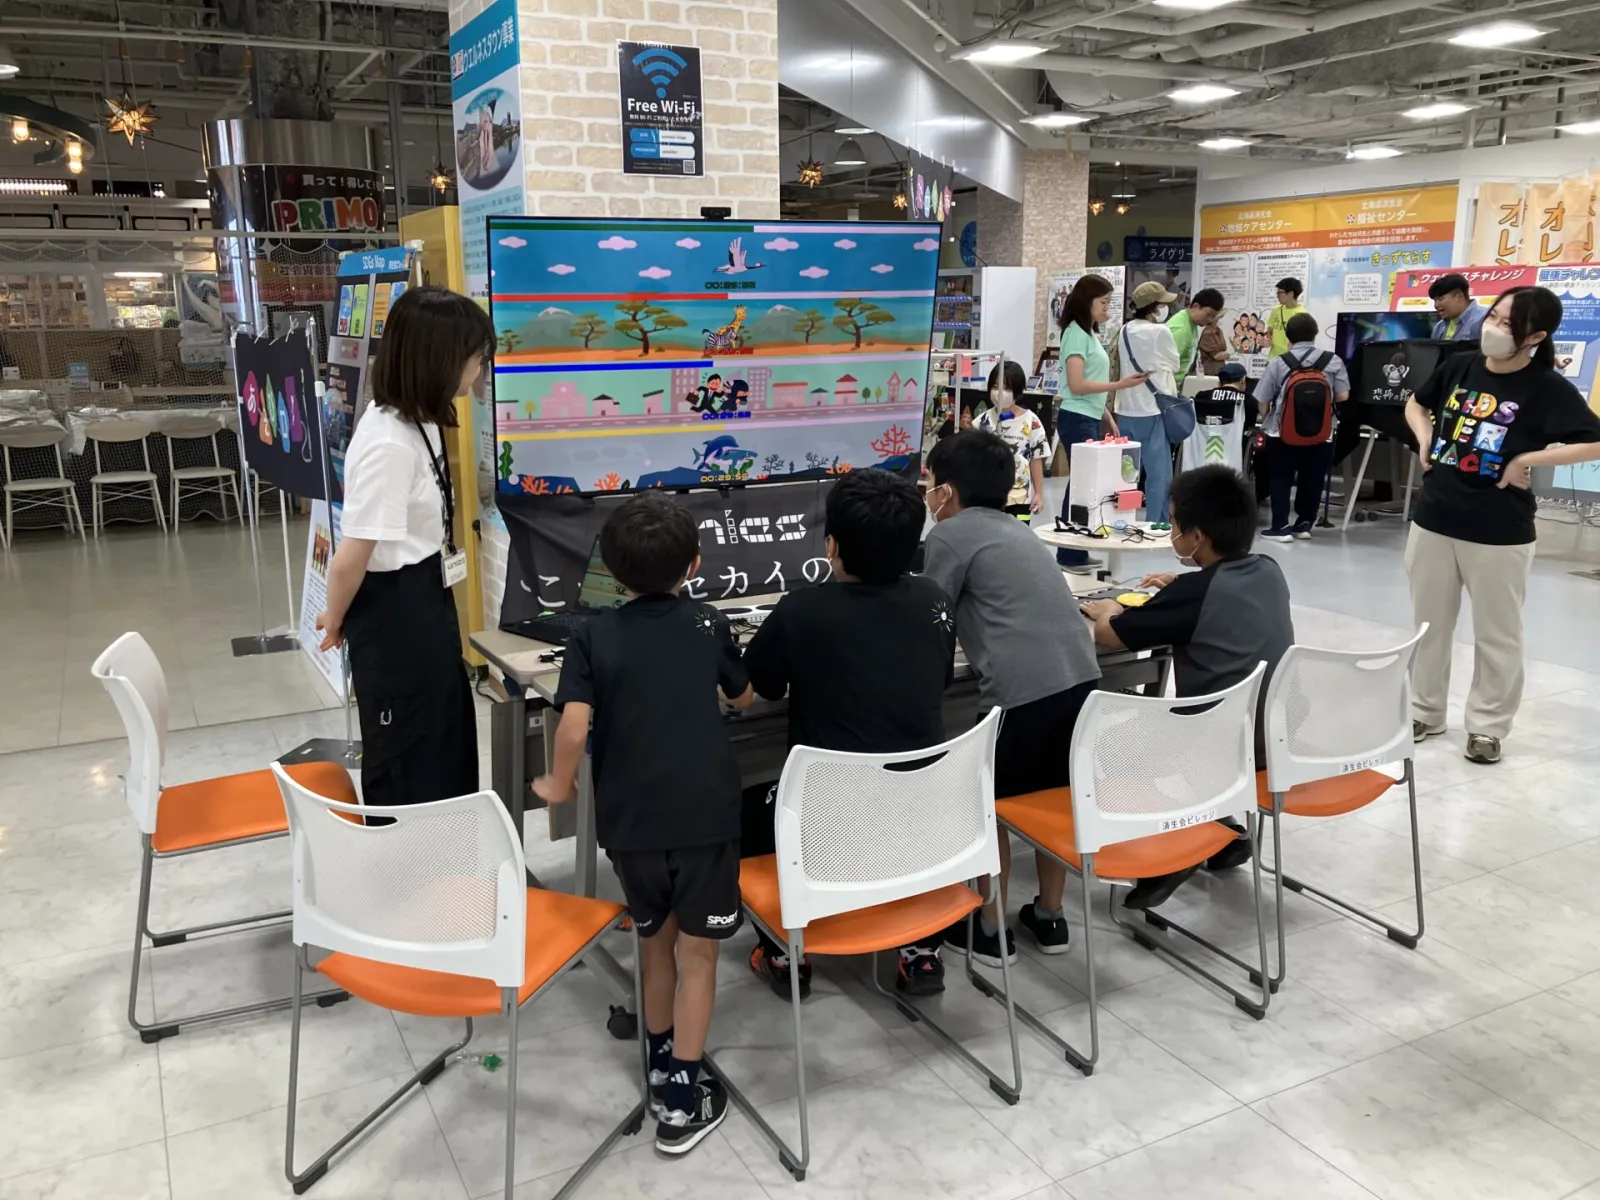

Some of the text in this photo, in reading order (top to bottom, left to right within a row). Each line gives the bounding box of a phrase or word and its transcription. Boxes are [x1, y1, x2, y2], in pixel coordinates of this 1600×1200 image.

[627, 97, 696, 115] Free Wi-Fi
[271, 196, 379, 233] PRIMO
[1356, 209, 1417, 225] 福祉センター
[1371, 249, 1432, 266] きっずてらす
[1446, 384, 1520, 424] KIDS
[1162, 810, 1215, 831] 済生会ビレッジ
